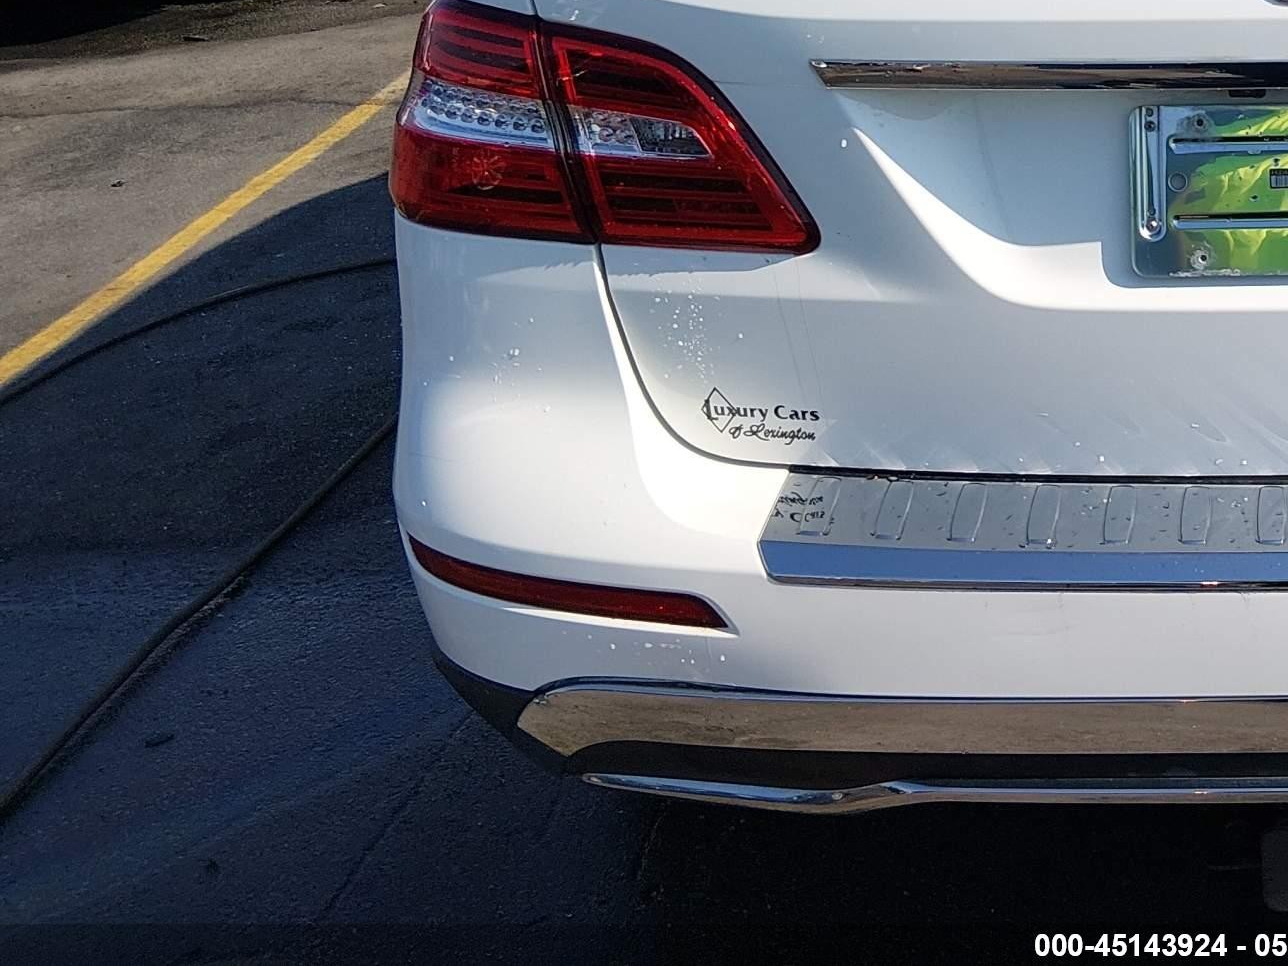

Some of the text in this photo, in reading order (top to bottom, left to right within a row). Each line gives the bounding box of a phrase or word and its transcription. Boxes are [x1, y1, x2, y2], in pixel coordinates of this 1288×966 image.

[702, 398, 820, 422] Luxury Cars
[744, 423, 816, 445] Lexington
